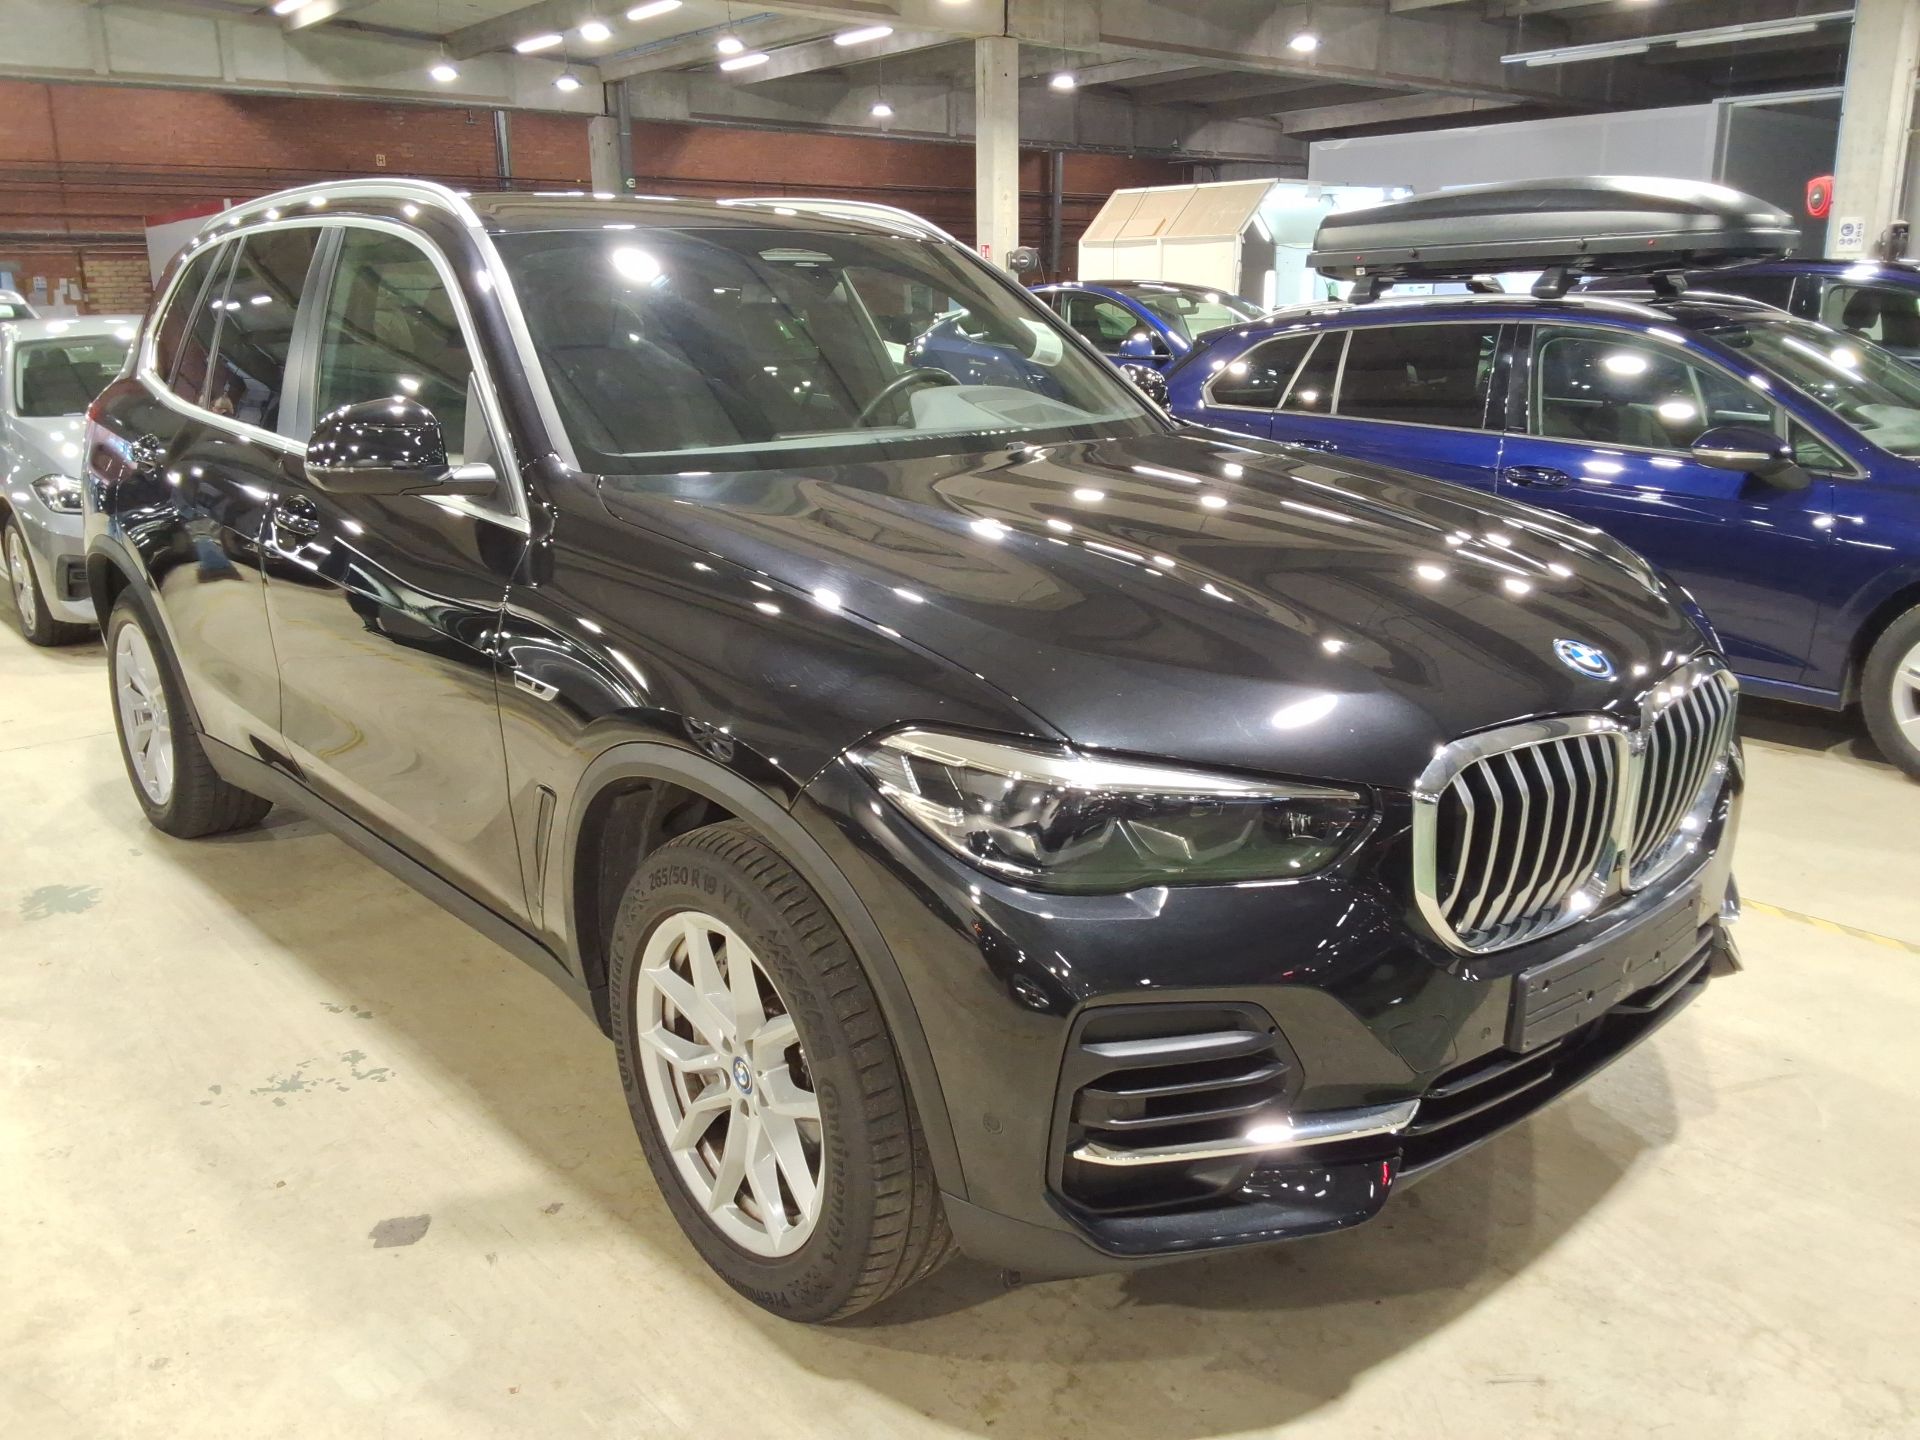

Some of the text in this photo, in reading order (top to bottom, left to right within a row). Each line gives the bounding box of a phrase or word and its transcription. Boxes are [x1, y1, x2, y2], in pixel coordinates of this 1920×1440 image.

[648, 864, 689, 891] 265/50
[691, 867, 701, 889] R
[818, 1076, 850, 1250] Continental
